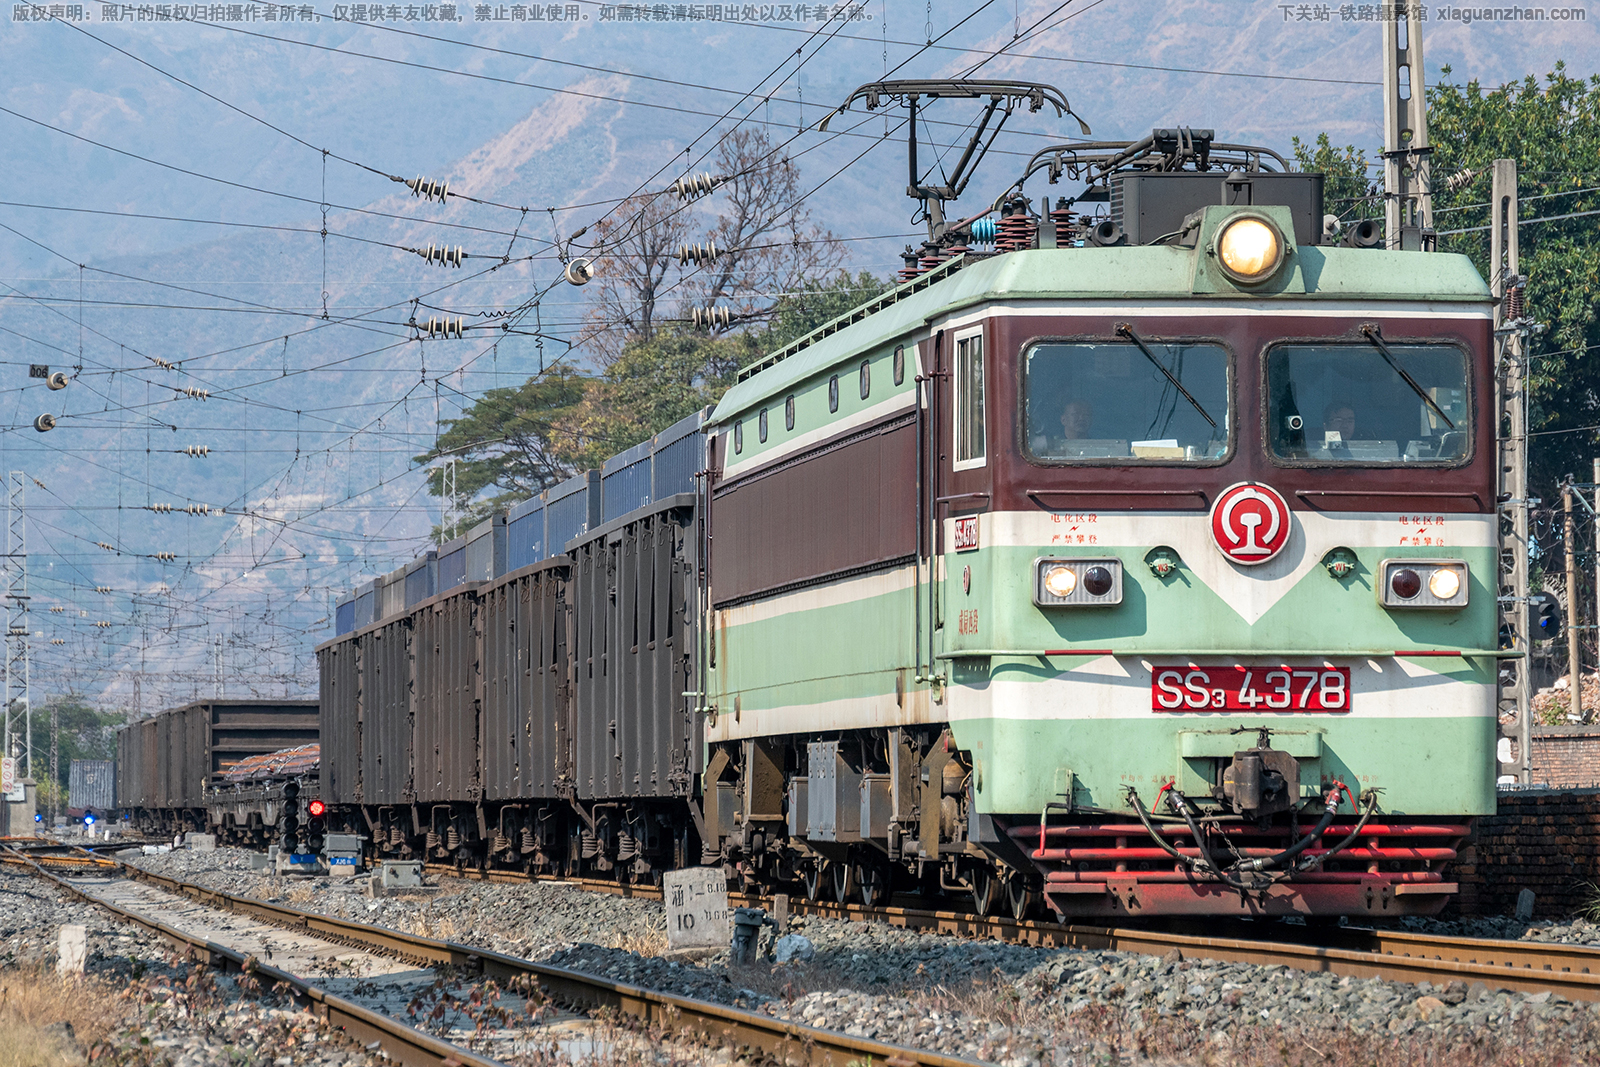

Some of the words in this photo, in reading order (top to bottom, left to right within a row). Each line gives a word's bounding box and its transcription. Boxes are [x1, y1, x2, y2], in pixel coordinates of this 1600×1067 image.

[1051, 513, 1098, 523] 电化区段
[1399, 515, 1445, 526] 电化区段
[1051, 534, 1098, 544] 严禁攀登
[1399, 536, 1445, 547] 严禁攀登
[1238, 671, 1346, 708] 4378
